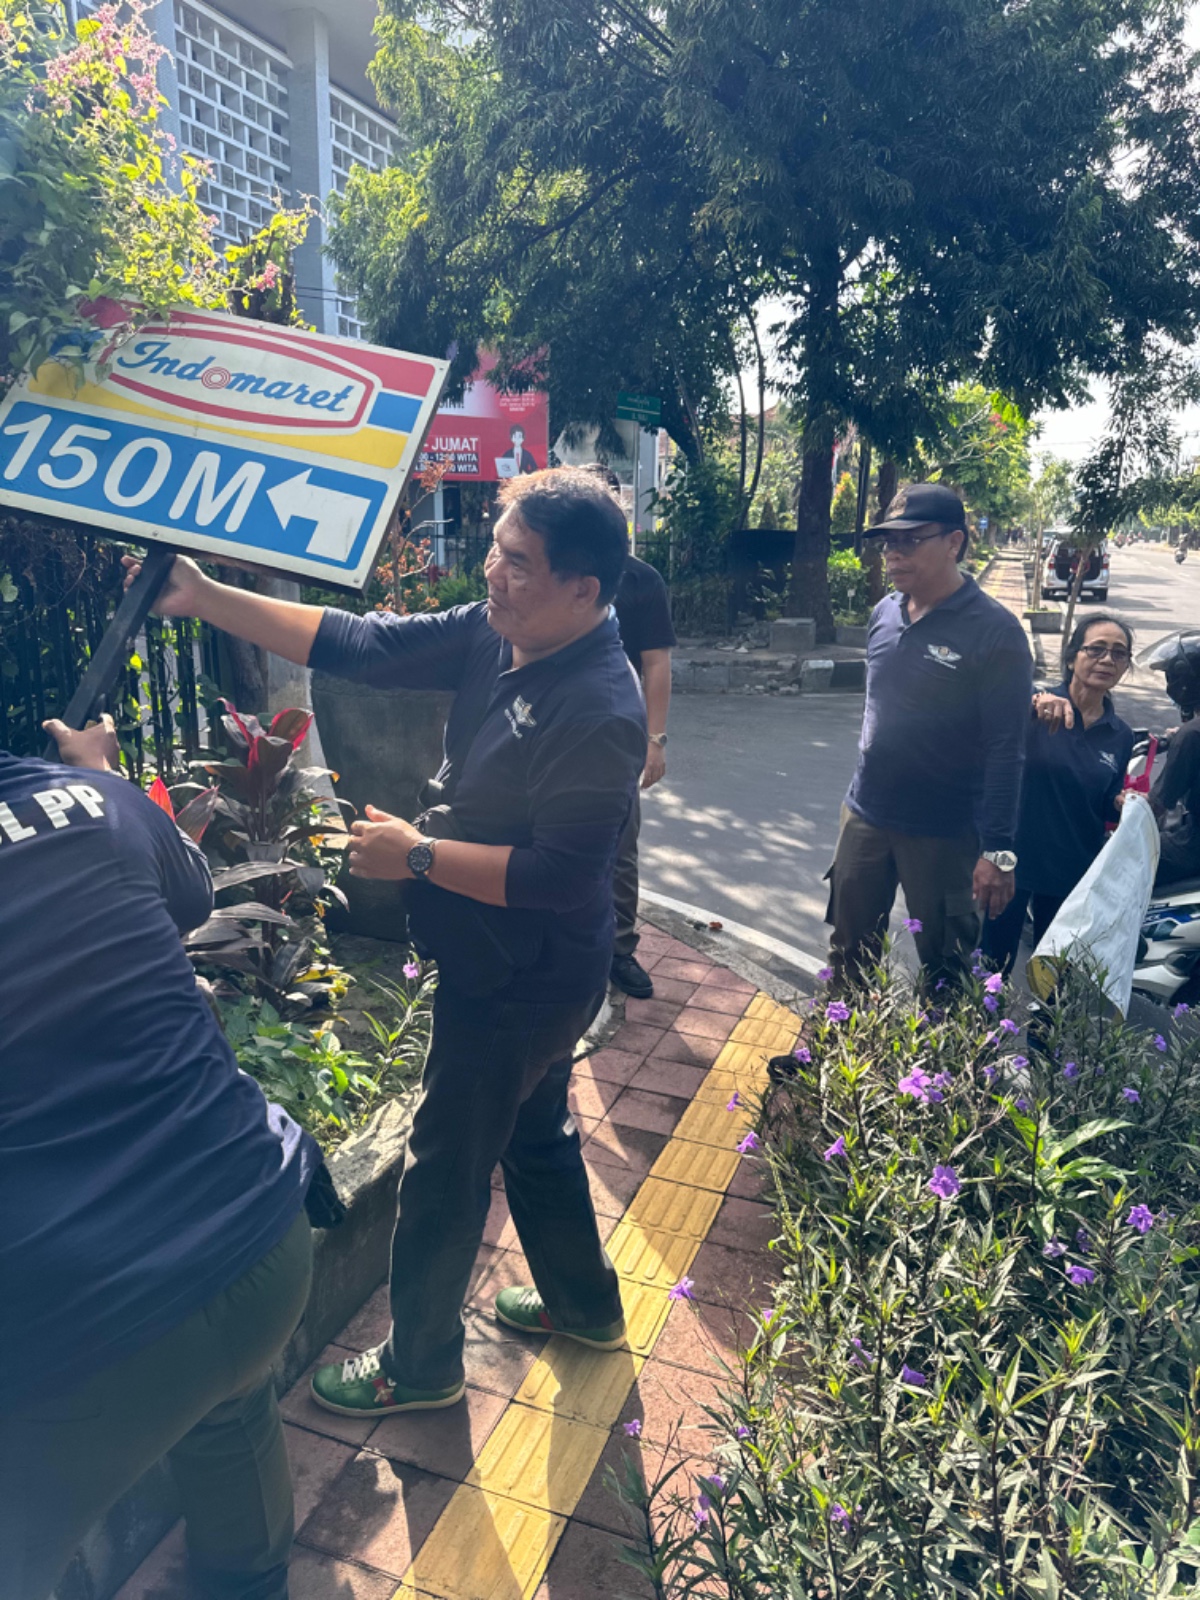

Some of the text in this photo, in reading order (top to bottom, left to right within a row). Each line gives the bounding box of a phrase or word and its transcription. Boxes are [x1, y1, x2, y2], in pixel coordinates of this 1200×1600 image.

[117, 341, 354, 412] Indomaret
[431, 437, 478, 451] JUMAT
[457, 453, 477, 461] WITA
[3, 414, 266, 533] 150M
[457, 464, 478, 472] WITA
[32, 785, 105, 829] PP
